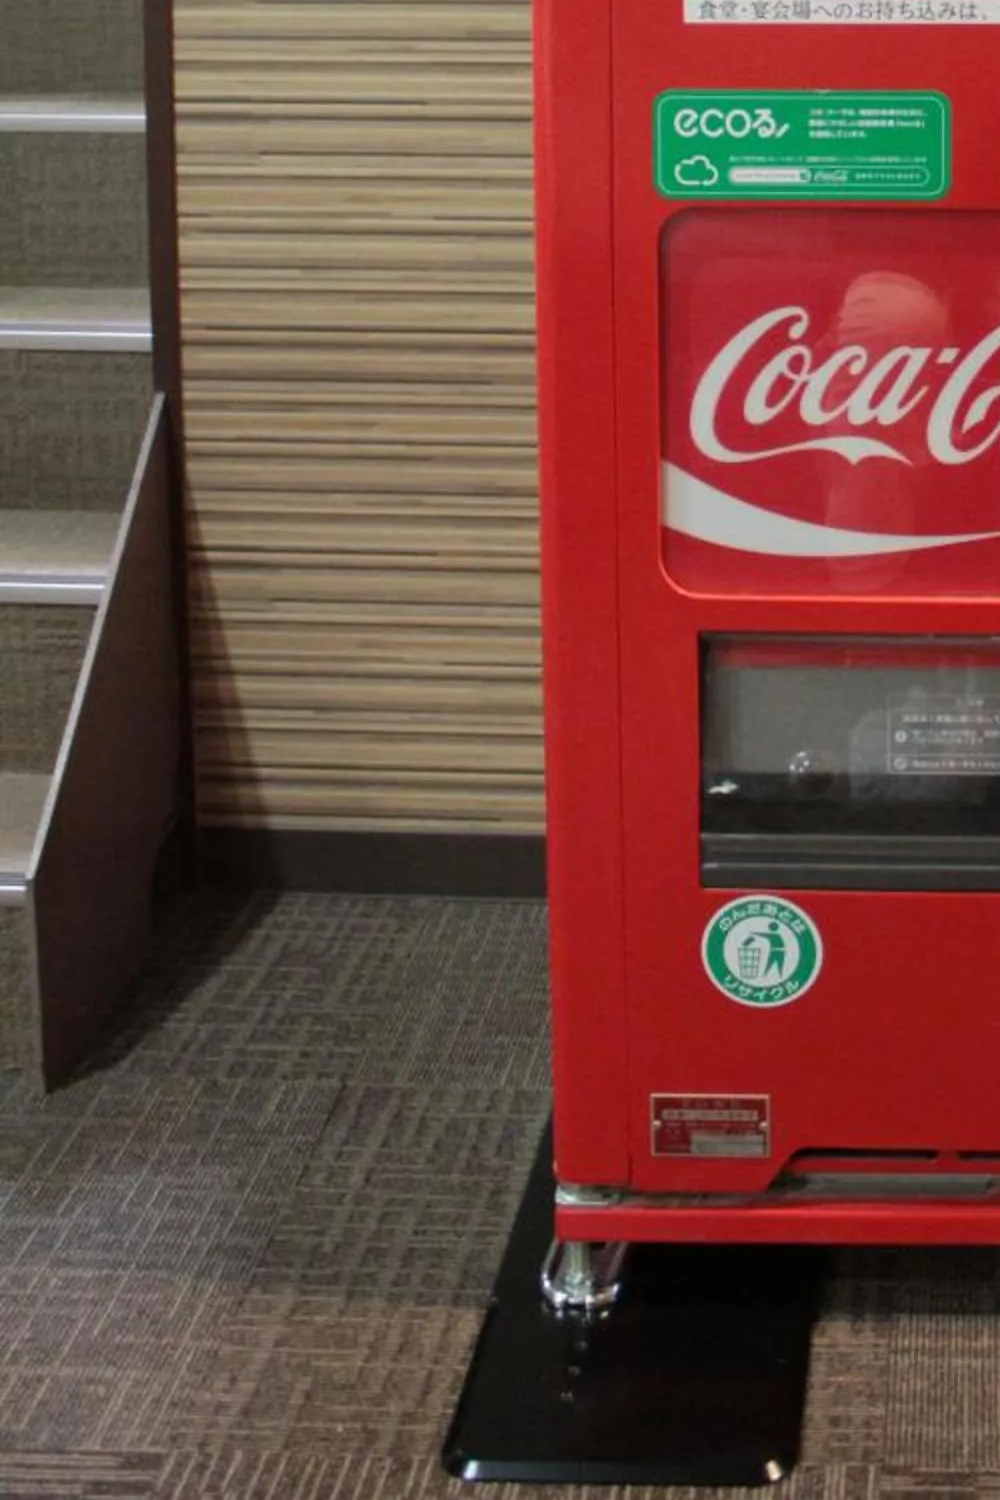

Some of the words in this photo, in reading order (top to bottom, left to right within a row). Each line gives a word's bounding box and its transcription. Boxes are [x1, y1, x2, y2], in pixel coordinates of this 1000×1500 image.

[723, 974, 800, 1002] リサイクル
